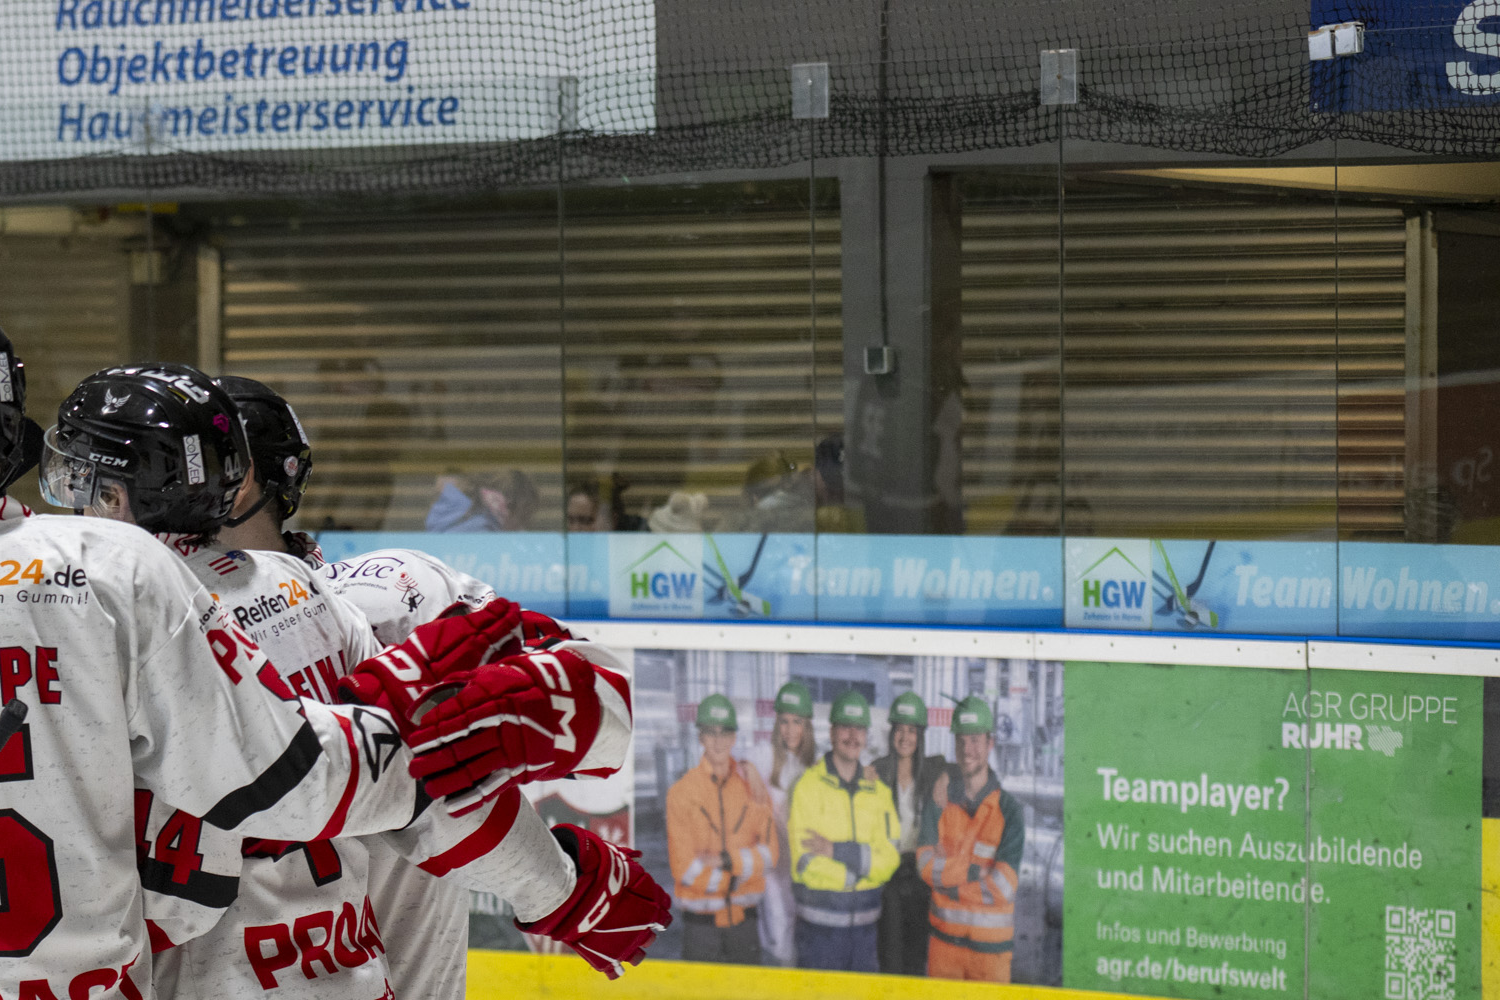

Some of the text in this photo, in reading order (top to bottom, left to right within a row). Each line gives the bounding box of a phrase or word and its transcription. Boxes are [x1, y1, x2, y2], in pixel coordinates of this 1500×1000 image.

[58, 39, 409, 95] Objektbetreuung
[58, 86, 459, 142] Haumeisterservice
[88, 452, 129, 468] CCM
[223, 454, 243, 481] 44
[631, 572, 697, 599] HGW
[789, 555, 1056, 602] Team Wohnen.
[1082, 579, 1147, 609] HGW
[1234, 564, 1500, 616] Team Wohnen.
[16, 589, 88, 606] Gummi!
[1282, 691, 1458, 725] AGR GRUPPE
[1282, 722, 1365, 751] RUHR
[1097, 766, 1290, 816] Teamplayer?
[1097, 823, 1423, 871] Wir suchen Auszubildende
[1097, 867, 1331, 904] und Mitarbeitende.
[244, 894, 386, 991] PROA
[1097, 921, 1287, 960] Infos und Bewerbung
[1096, 956, 1288, 991] agr.de/berufswelt
